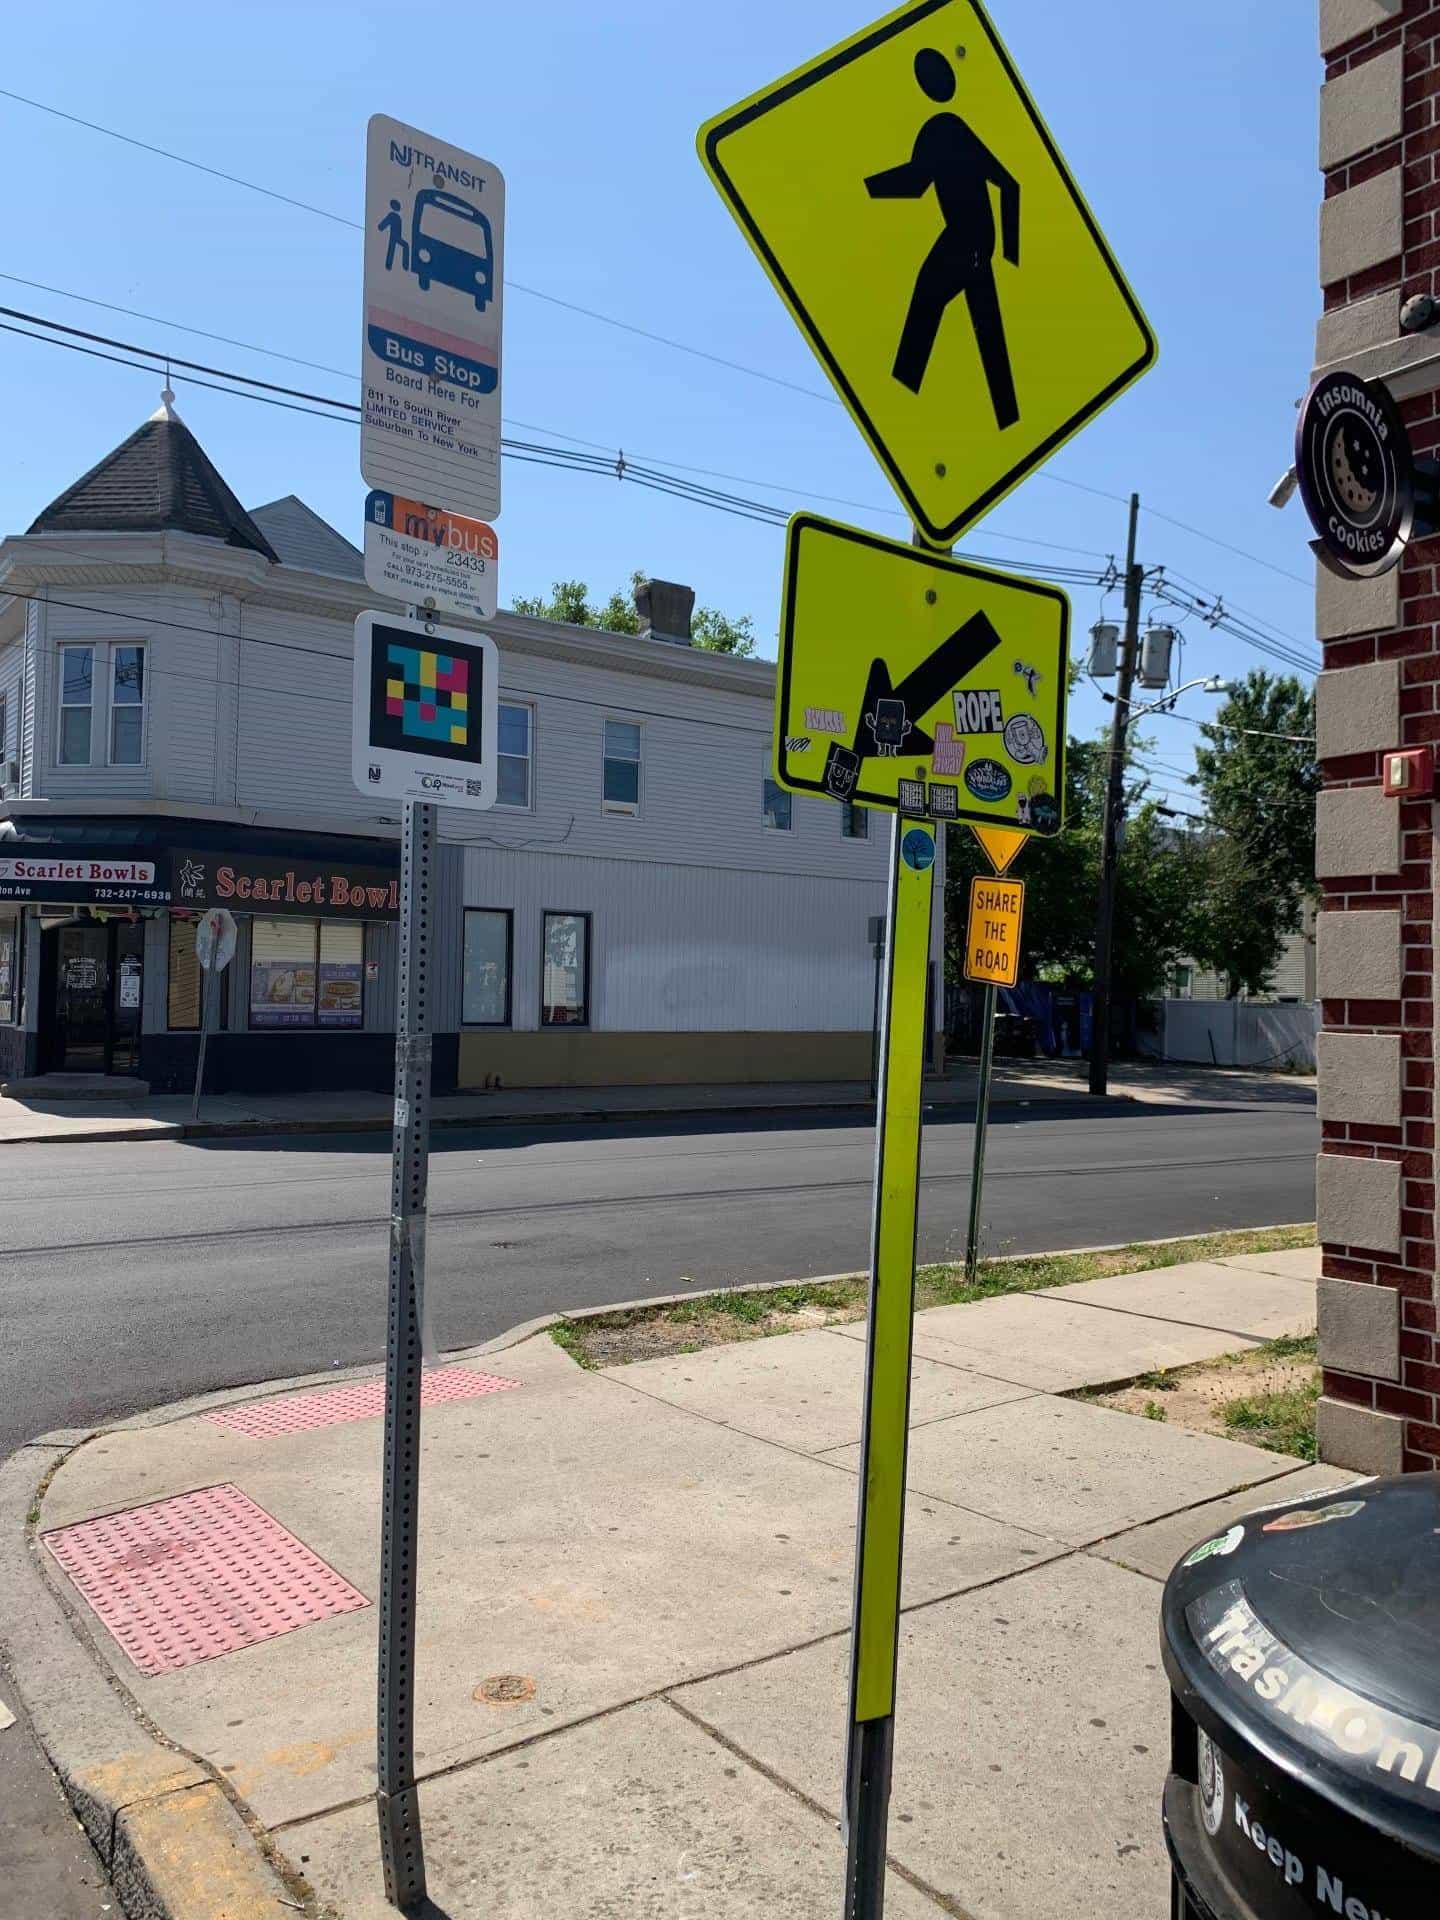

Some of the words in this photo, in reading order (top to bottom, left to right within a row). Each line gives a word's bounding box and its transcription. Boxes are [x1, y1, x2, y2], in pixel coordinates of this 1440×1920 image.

[386, 338, 424, 367] Bus
[434, 356, 480, 386] Stop
[386, 367, 423, 391] Board
[428, 380, 456, 401] Here
[461, 392, 480, 409] For
[366, 402, 407, 421] LIMITED
[412, 414, 455, 435] SERVICE
[368, 389, 384, 401] 811
[388, 395, 399, 407] To
[404, 401, 433, 417] South
[437, 411, 461, 426] River
[1316, 385, 1388, 440] insomnia
[365, 414, 413, 437] Suburban
[418, 430, 429, 441] To
[433, 435, 454, 449] New
[457, 441, 479, 457] York
[405, 512, 493, 558] mybus
[1328, 515, 1385, 552] cookies
[379, 533, 398, 548] This
[401, 543, 420, 556] stop
[446, 551, 485, 573] 23433
[384, 570, 400, 581] TEXT
[386, 562, 403, 572] CALL
[406, 564, 468, 589] 973-275-5555
[953, 691, 1005, 733] ROPE
[14, 861, 83, 879] Scarlet
[89, 863, 148, 881] Bowls
[215, 867, 325, 904] Scarlet
[330, 876, 401, 910] Bowl
[976, 890, 1018, 914] SHARE
[984, 920, 1007, 942] THE
[975, 948, 1009, 971] ROAD
[1235, 1792, 1304, 1885] Keep
[1317, 1865, 1395, 1920] Ne
